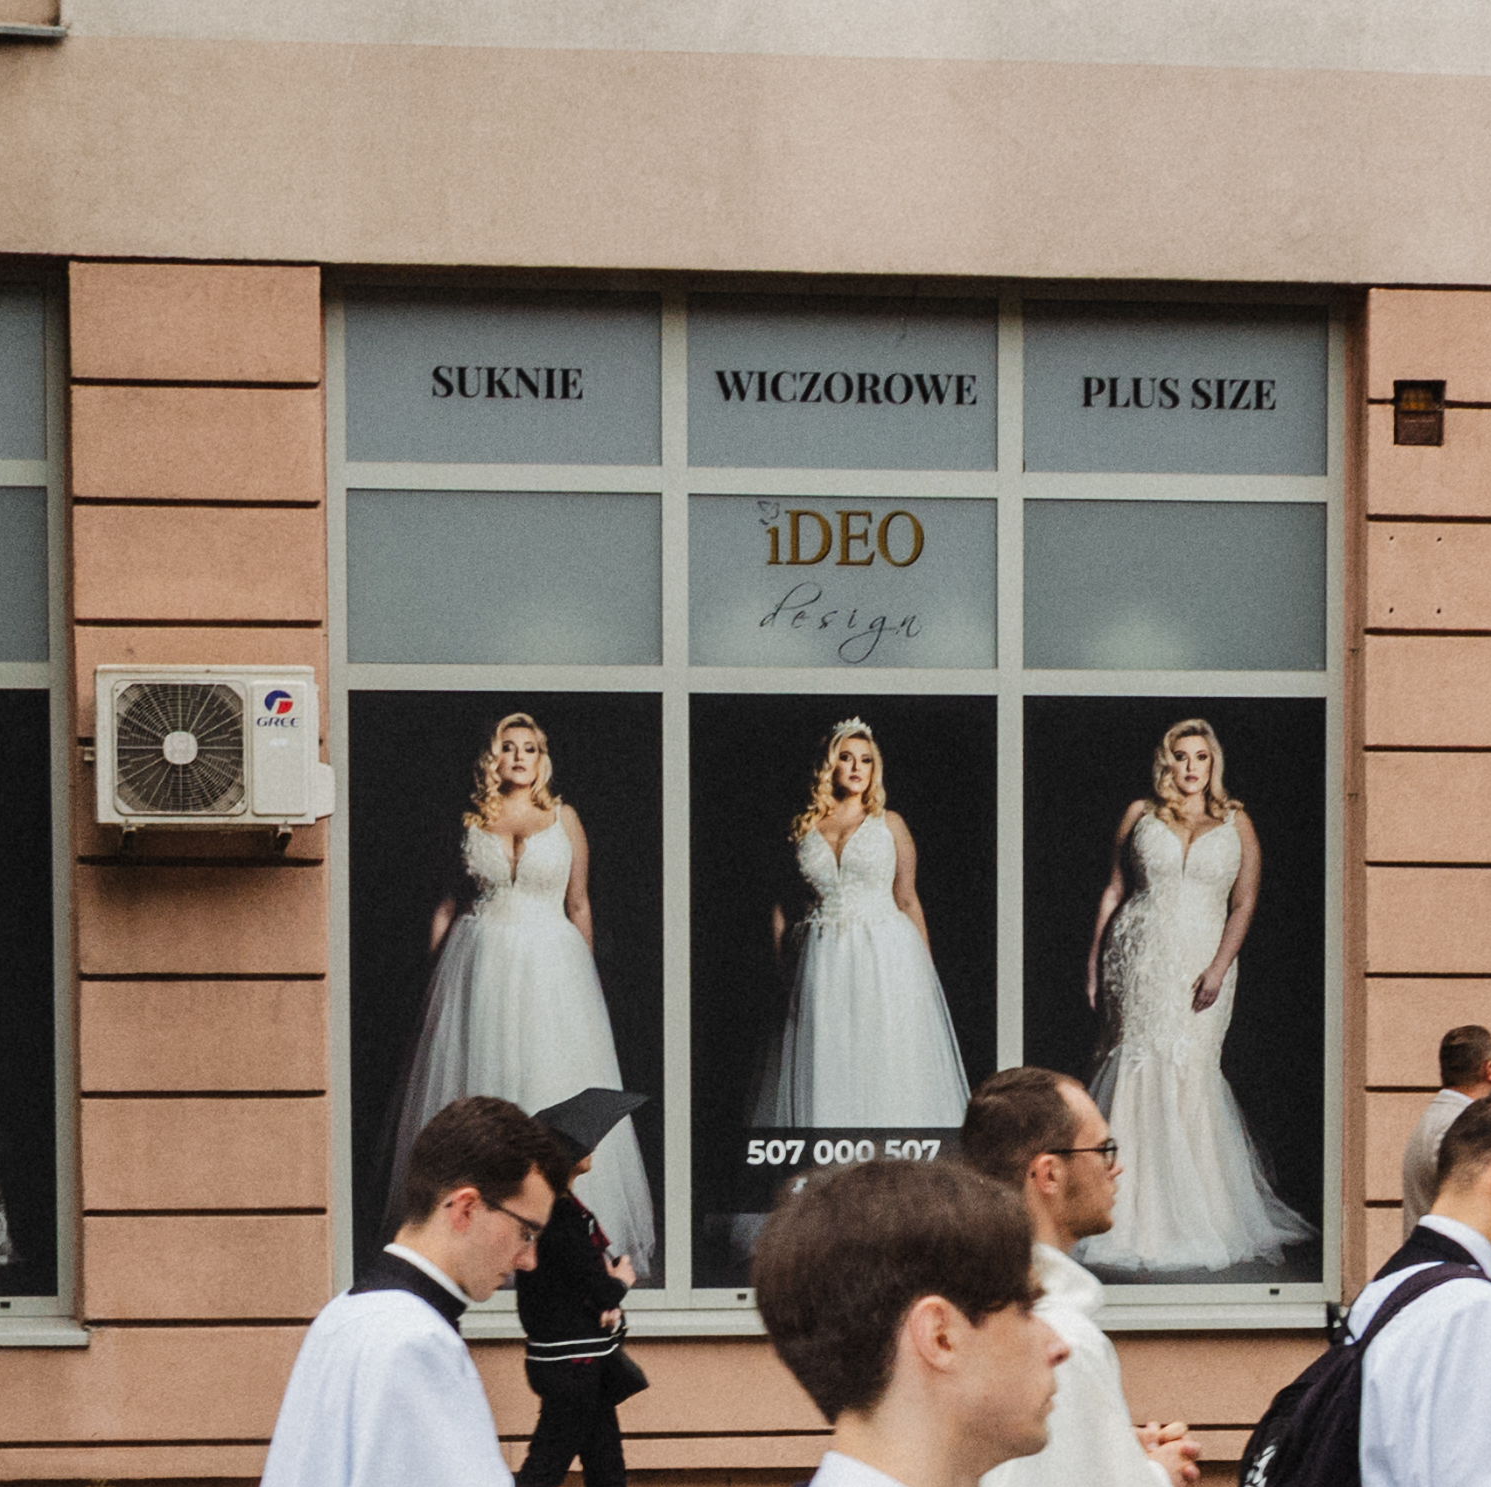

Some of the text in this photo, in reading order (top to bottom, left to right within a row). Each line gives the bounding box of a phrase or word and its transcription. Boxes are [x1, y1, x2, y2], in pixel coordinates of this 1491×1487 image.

[431, 365, 1277, 411] SUKNIE WICZOROWE PLUS SIZE
[759, 581, 921, 664] design
[256, 716, 301, 728] GREE
[746, 1139, 942, 1165] 507 000 507
